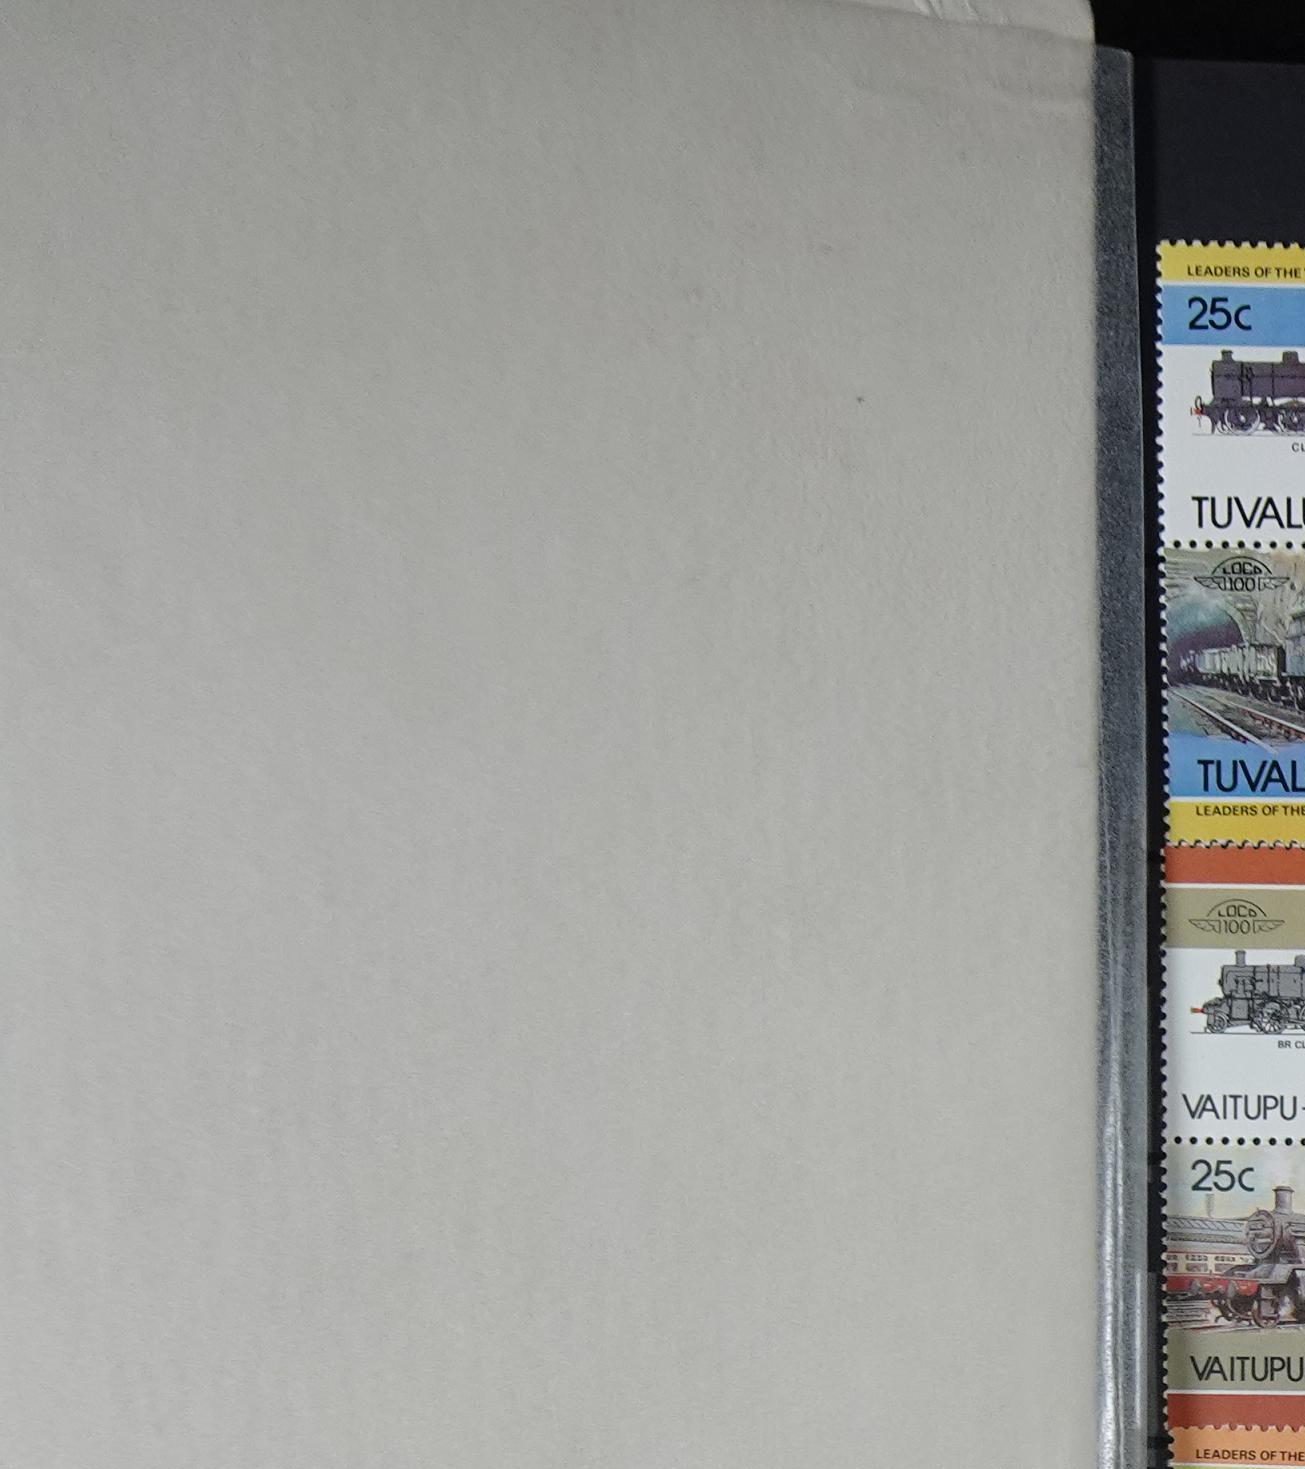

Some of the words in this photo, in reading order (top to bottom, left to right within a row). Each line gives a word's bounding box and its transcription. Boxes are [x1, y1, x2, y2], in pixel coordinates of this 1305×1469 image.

[1187, 265, 1250, 278] LEADERS
[1254, 266, 1272, 279] OF
[1275, 267, 1301, 279] THE
[1188, 297, 1253, 331] 25c
[1190, 1160, 1255, 1193] 25c
